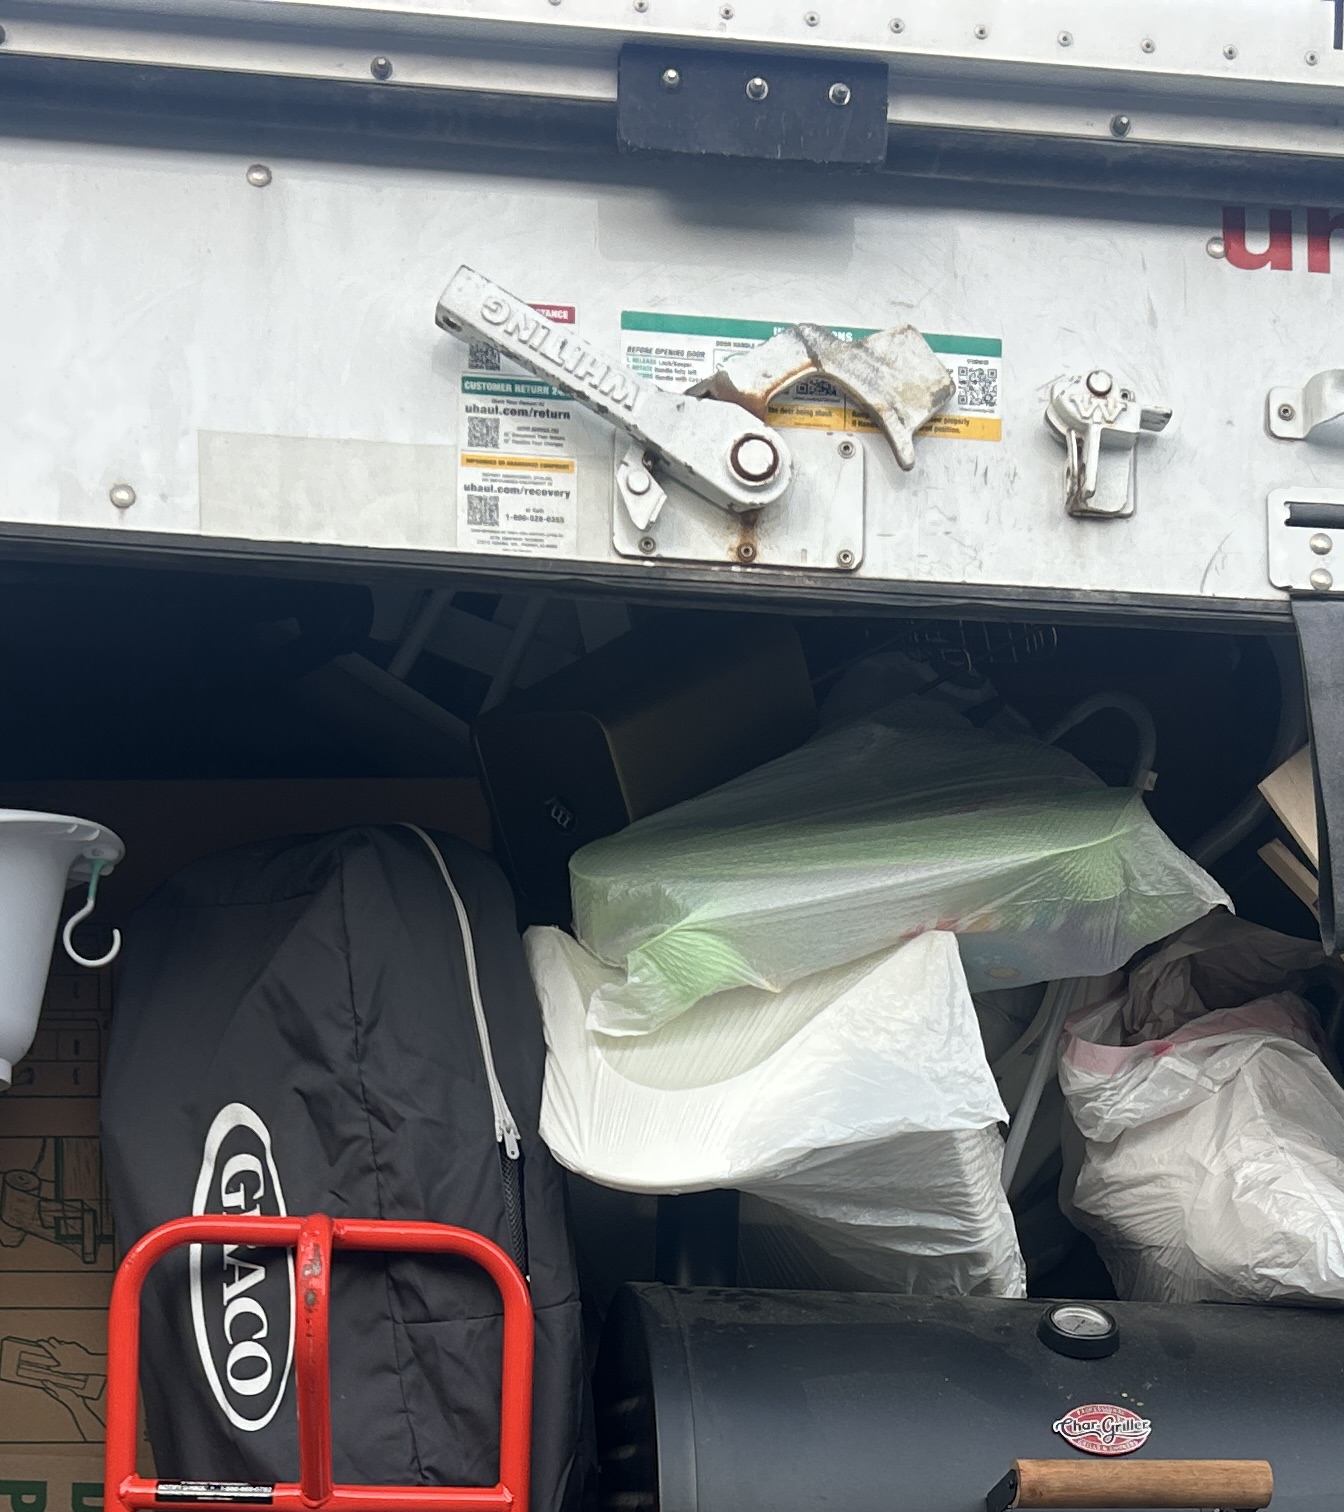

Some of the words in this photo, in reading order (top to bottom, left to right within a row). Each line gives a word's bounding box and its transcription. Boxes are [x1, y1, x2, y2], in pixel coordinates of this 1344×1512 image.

[480, 295, 641, 411] WHITING
[464, 382, 512, 393] CUSTOMER
[514, 383, 549, 395] RETURN
[465, 404, 570, 420] uhaul.com/return
[464, 484, 570, 499] uhaul.com/recovery
[1056, 1416, 1149, 1443] Char-Griller
